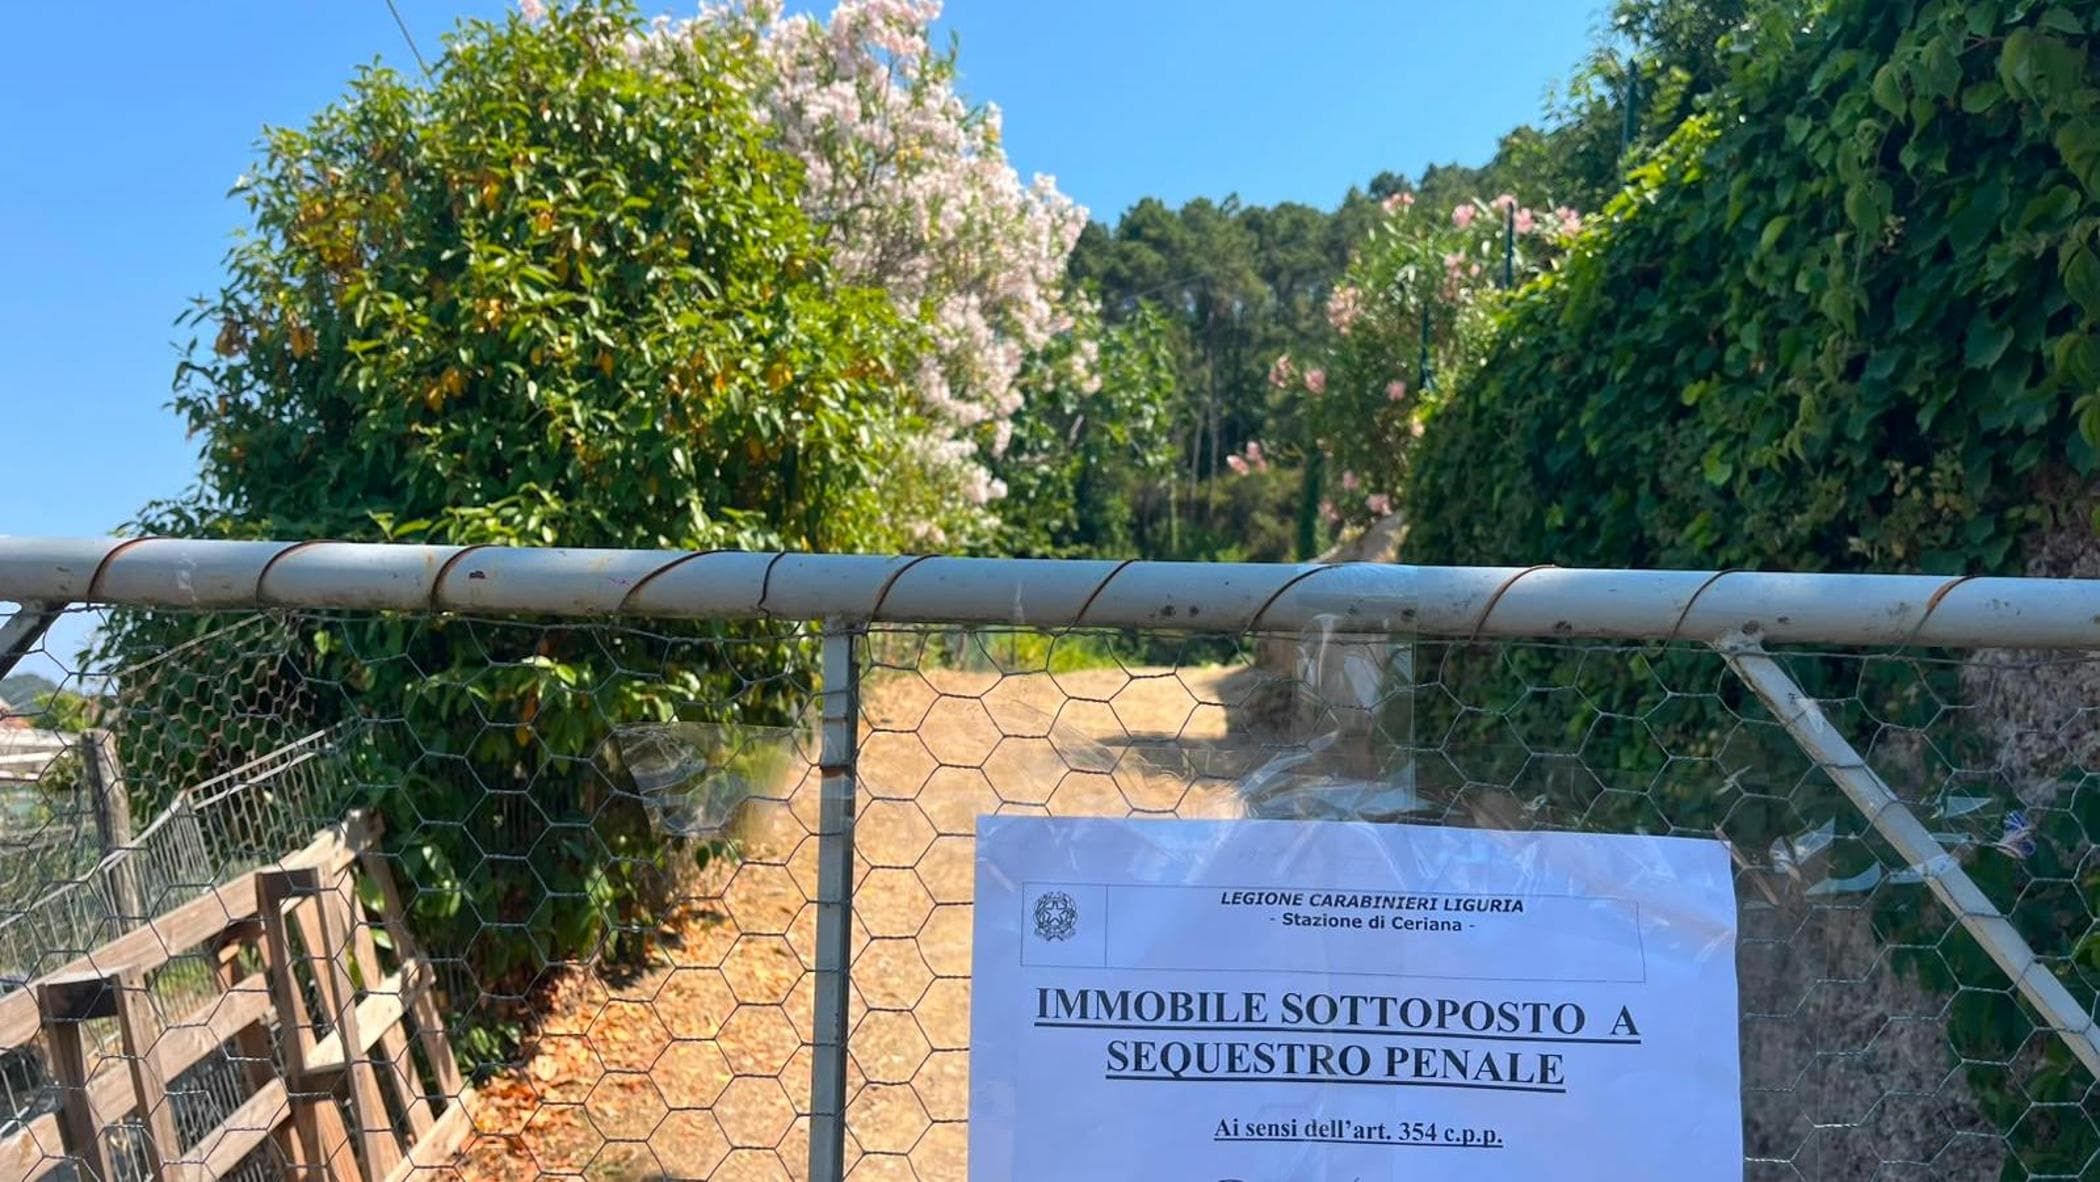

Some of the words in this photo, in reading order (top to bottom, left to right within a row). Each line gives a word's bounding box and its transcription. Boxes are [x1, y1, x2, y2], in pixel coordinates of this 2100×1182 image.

[1220, 892, 1304, 907] LEGIONE
[1308, 893, 1440, 911] CARABINIERI
[1443, 898, 1525, 913] LIGURIA
[1281, 911, 1363, 929] Stazione
[1367, 914, 1386, 931] di
[1391, 915, 1463, 933] Ceriana
[1035, 986, 1268, 1024] IMMOBILE
[1280, 992, 1586, 1035] SOTTOPOSTO
[1609, 1004, 1640, 1036] A
[1106, 1039, 1371, 1079] SEQUESTRO
[1385, 1047, 1565, 1086] PENALE
[1214, 1118, 1240, 1137] Ai
[1245, 1118, 1298, 1138] sensi
[1398, 1121, 1438, 1142] 354
[1443, 1126, 1503, 1147] c.p.p.
